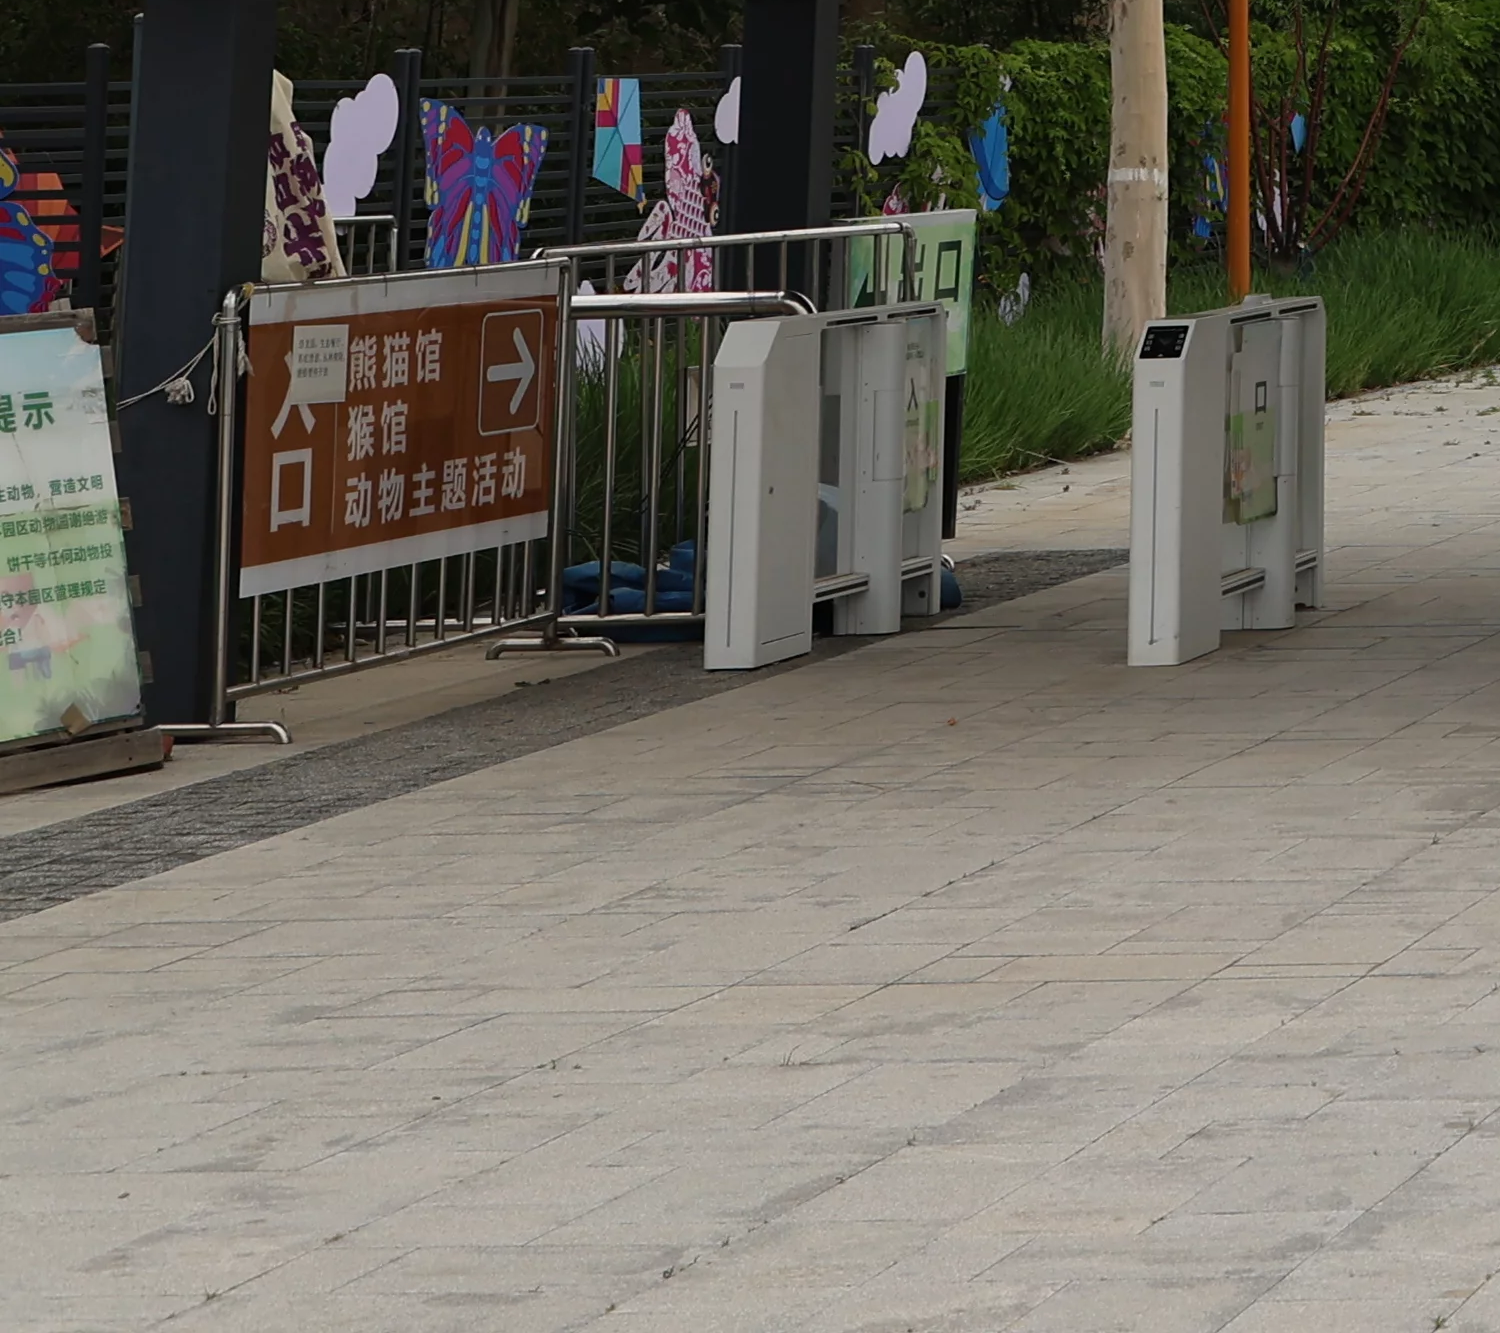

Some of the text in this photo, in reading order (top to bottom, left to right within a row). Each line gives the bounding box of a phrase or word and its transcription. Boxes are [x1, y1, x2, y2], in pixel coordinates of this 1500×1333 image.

[349, 328, 442, 393] 熊猫馆
[347, 399, 408, 462] 猴馆
[344, 446, 527, 529] 动物主题活动
[0, 578, 108, 611] 守本园区管理规定
